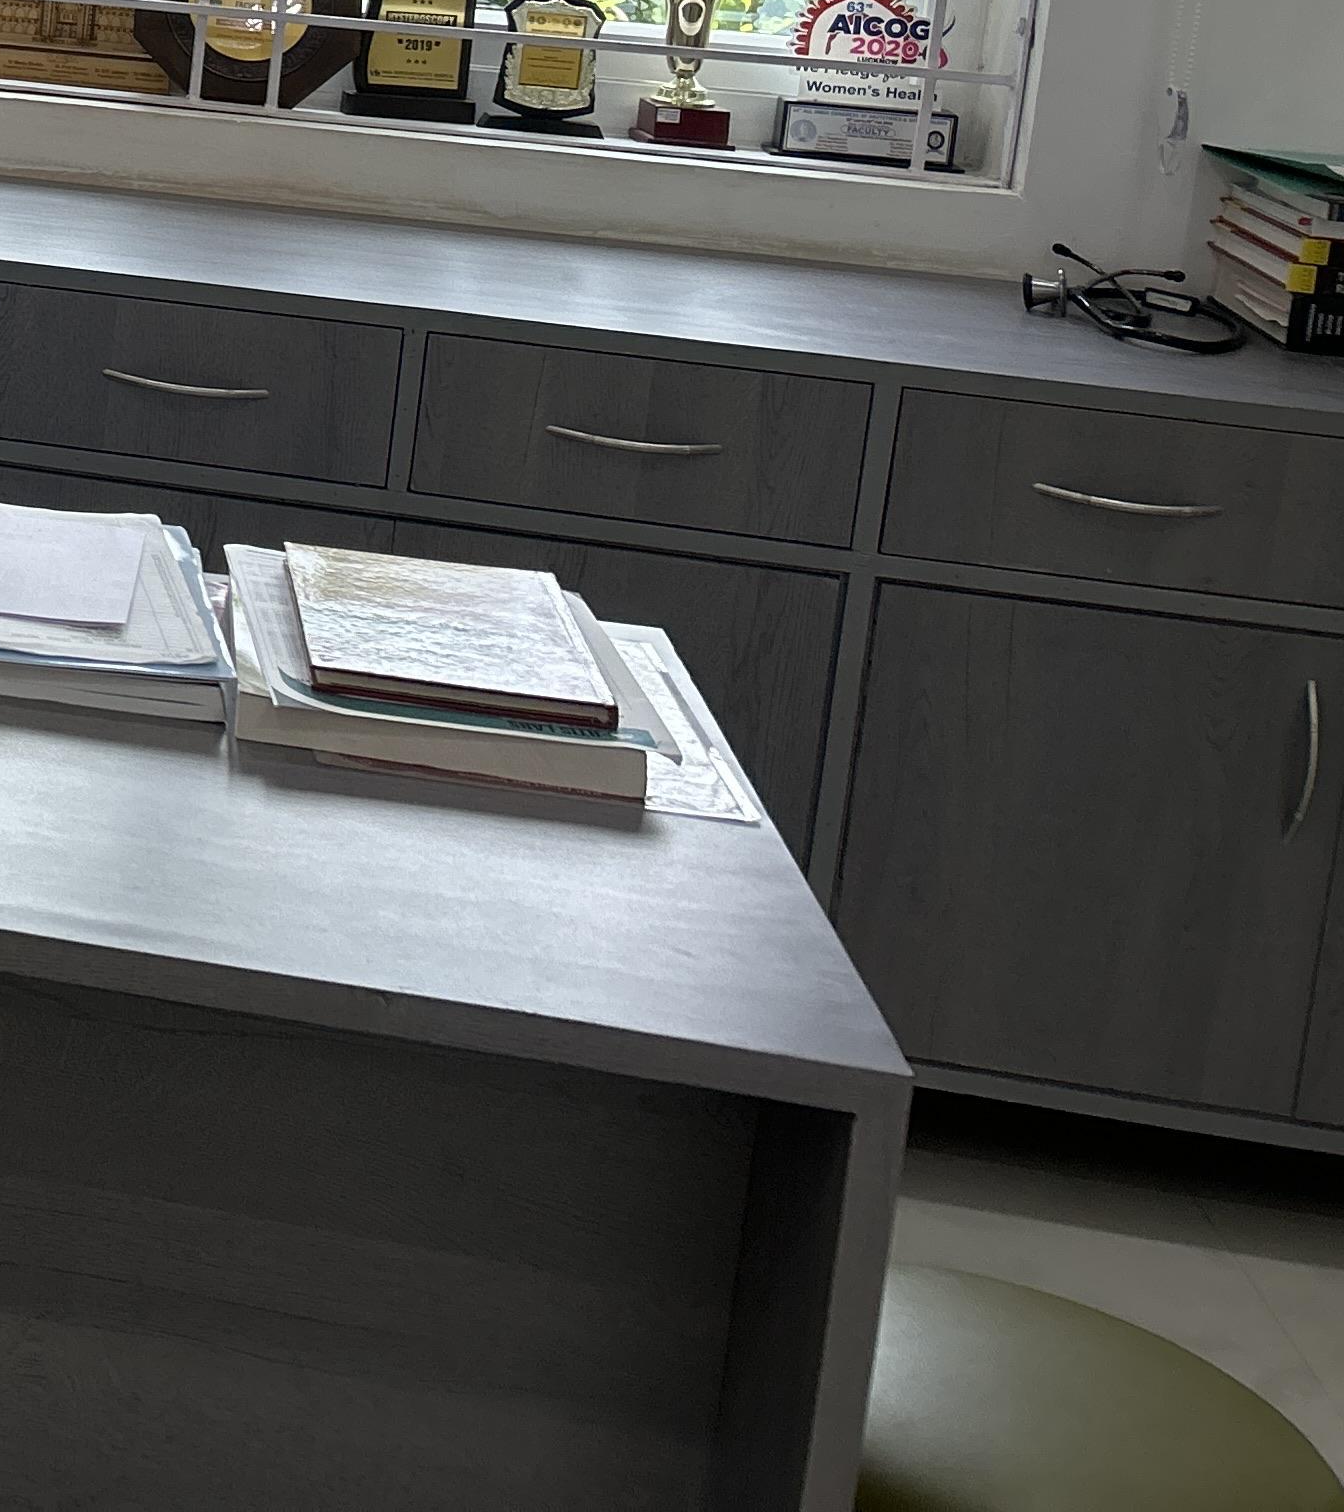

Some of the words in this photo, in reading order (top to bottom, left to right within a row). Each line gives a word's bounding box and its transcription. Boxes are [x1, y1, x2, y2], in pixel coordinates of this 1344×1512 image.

[826, 13, 931, 41] AICOG
[849, 36, 920, 59] 2020
[806, 80, 881, 98] Women's
